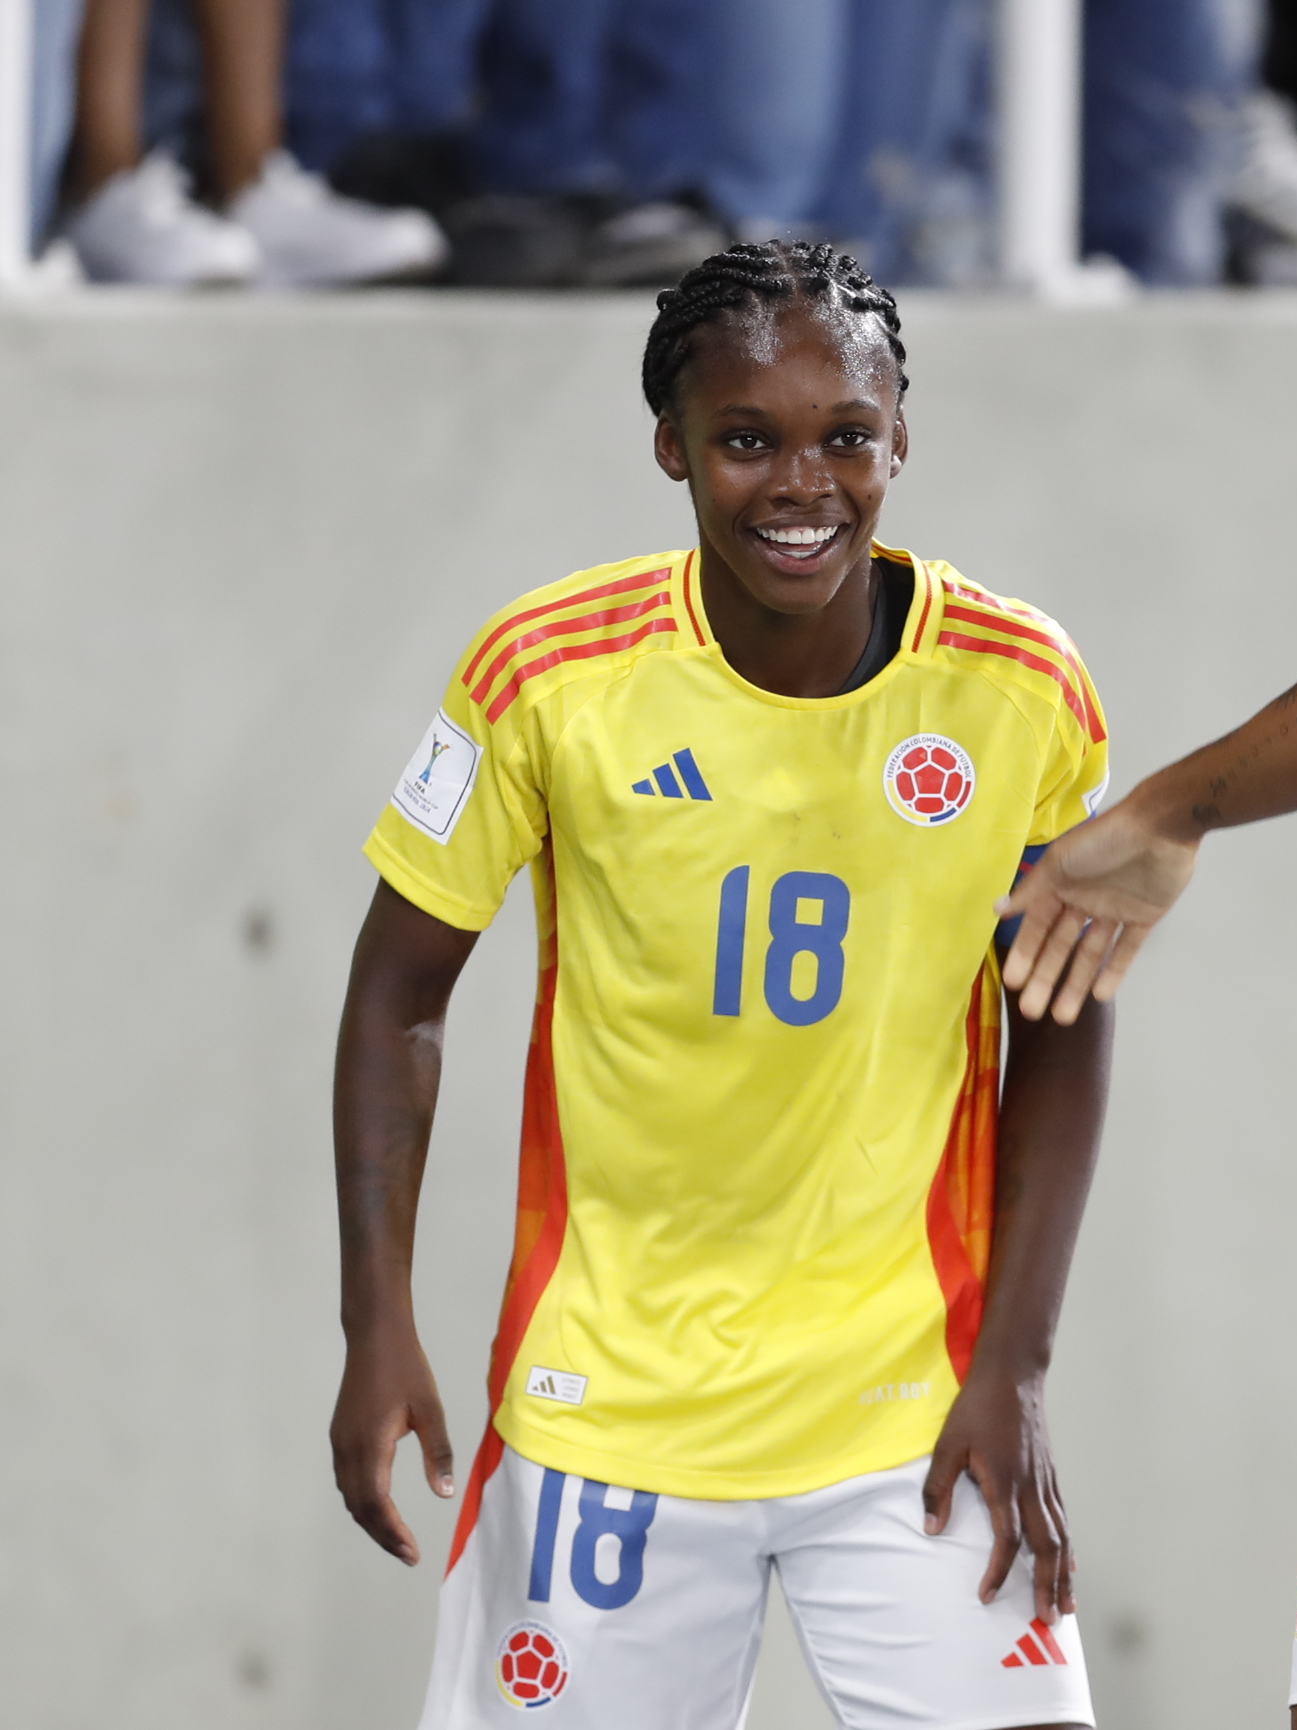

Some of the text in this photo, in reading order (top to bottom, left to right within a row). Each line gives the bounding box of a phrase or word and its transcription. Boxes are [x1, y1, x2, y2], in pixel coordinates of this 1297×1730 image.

[910, 737, 952, 749] COLOMBIANA
[713, 865, 850, 1026] 18
[527, 1467, 660, 1612] 18
